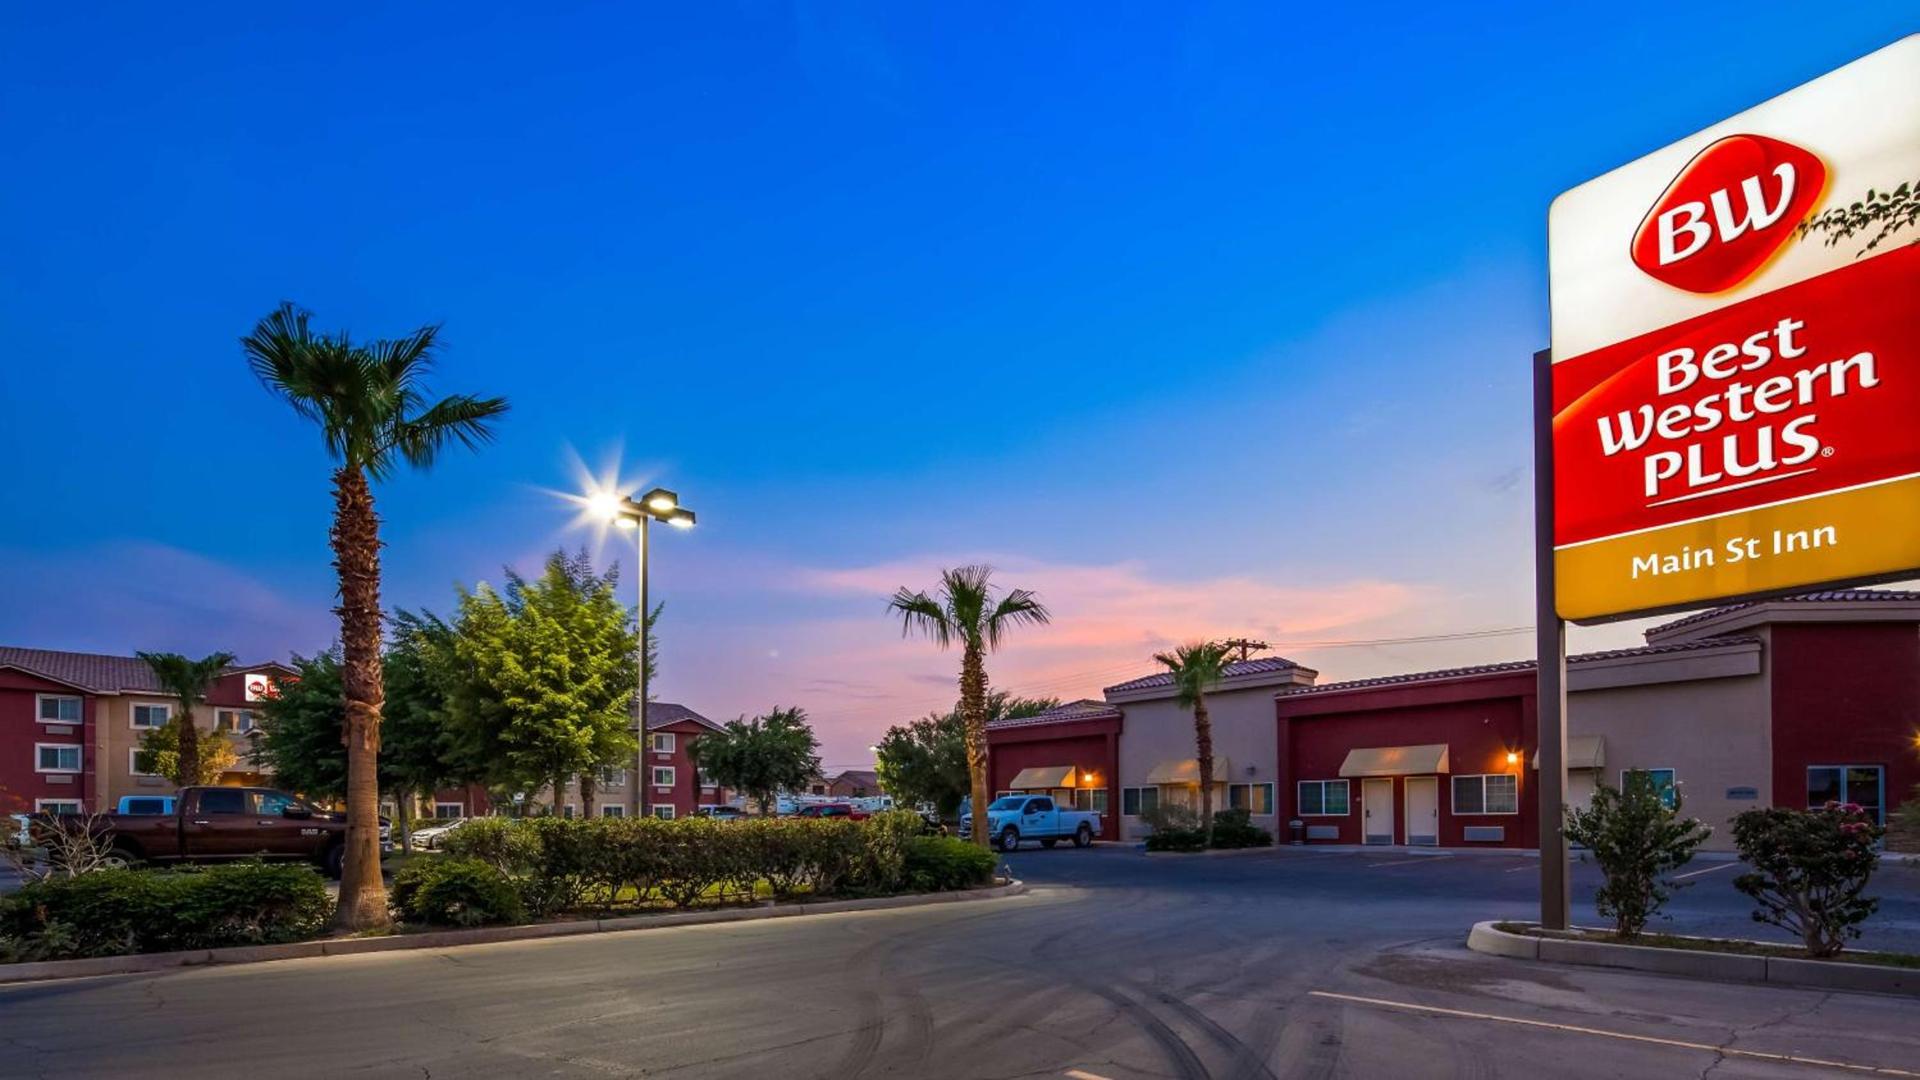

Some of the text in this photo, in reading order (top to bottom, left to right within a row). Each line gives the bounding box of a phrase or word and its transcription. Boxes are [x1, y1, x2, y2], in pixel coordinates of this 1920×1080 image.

[1658, 162, 1796, 266] BW
[1657, 318, 1807, 395] Best
[1597, 352, 1880, 456] Western
[1632, 525, 1837, 579] Main St Inn
